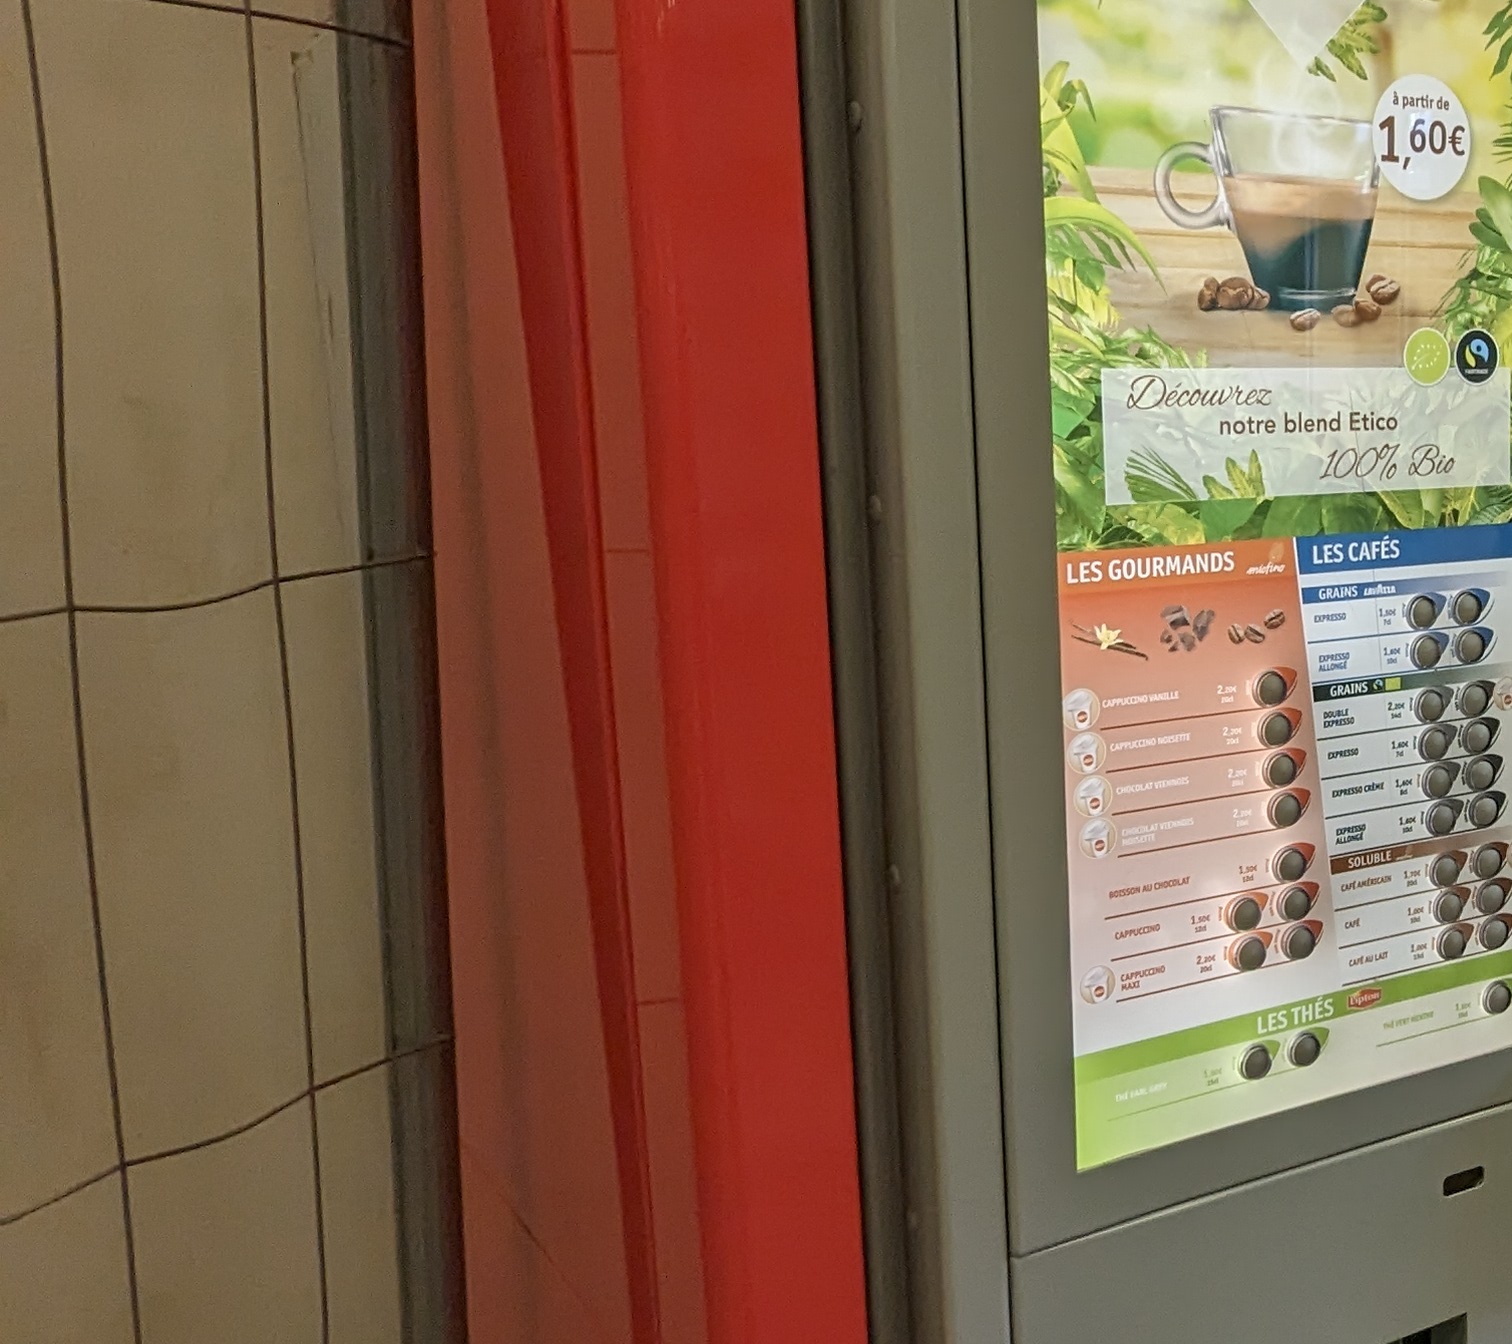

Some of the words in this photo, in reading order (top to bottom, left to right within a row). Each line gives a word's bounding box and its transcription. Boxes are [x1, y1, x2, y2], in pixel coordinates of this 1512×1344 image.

[1393, 91, 1399, 105] à
[1403, 95, 1434, 109] partir
[1437, 97, 1449, 110] de
[1379, 115, 1465, 170] 1,60€
[1127, 374, 1273, 409] Découvrez
[1220, 414, 1276, 435] notre
[1284, 411, 1341, 434] blend
[1350, 411, 1398, 431] Etico
[1320, 443, 1401, 481] 100%
[1408, 444, 1455, 476] Bio
[1313, 544, 1343, 564] LES
[1349, 536, 1400, 562] CAFÉS
[1067, 561, 1102, 584] LES
[1108, 552, 1234, 580] GOURMANDS
[1319, 586, 1358, 600] GRAINS
[1314, 613, 1346, 623] EXPRESSO
[1319, 652, 1349, 662] EXPRESSO
[1330, 682, 1368, 697] GRAINS
[1102, 694, 1147, 709] CAPPUCCINO
[1149, 691, 1179, 703] VANILLE
[1323, 708, 1349, 720] DOUBLE
[1323, 717, 1355, 729] EXPRESSO
[1110, 736, 1156, 751] CAPPUCCINO
[1328, 748, 1358, 760] EXPRESSO
[1116, 781, 1153, 794] CHOCOLAT
[1332, 785, 1363, 798] EXPRESSO
[1336, 824, 1366, 836] EXPRESSO
[1348, 850, 1392, 869] SOLUBLE
[1109, 885, 1141, 899] BOISSON
[1142, 883, 1153, 894] AU
[1153, 876, 1191, 891] CHOCOLAT
[1341, 881, 1357, 892] CAFÉ
[1357, 874, 1392, 888] AMÉRICAIN
[1115, 923, 1161, 940] CAPPUCCINO
[1345, 918, 1360, 929] CAFÉ
[1349, 955, 1364, 967] CAFÉ
[1364, 954, 1372, 963] AU
[1374, 951, 1388, 962] LAIT
[1121, 965, 1166, 981] CAPPUCCINO
[1121, 980, 1140, 992] MAXI
[1350, 991, 1381, 1006] Lipton
[1256, 1011, 1288, 1035] LES
[1291, 997, 1334, 1028] THÉS
